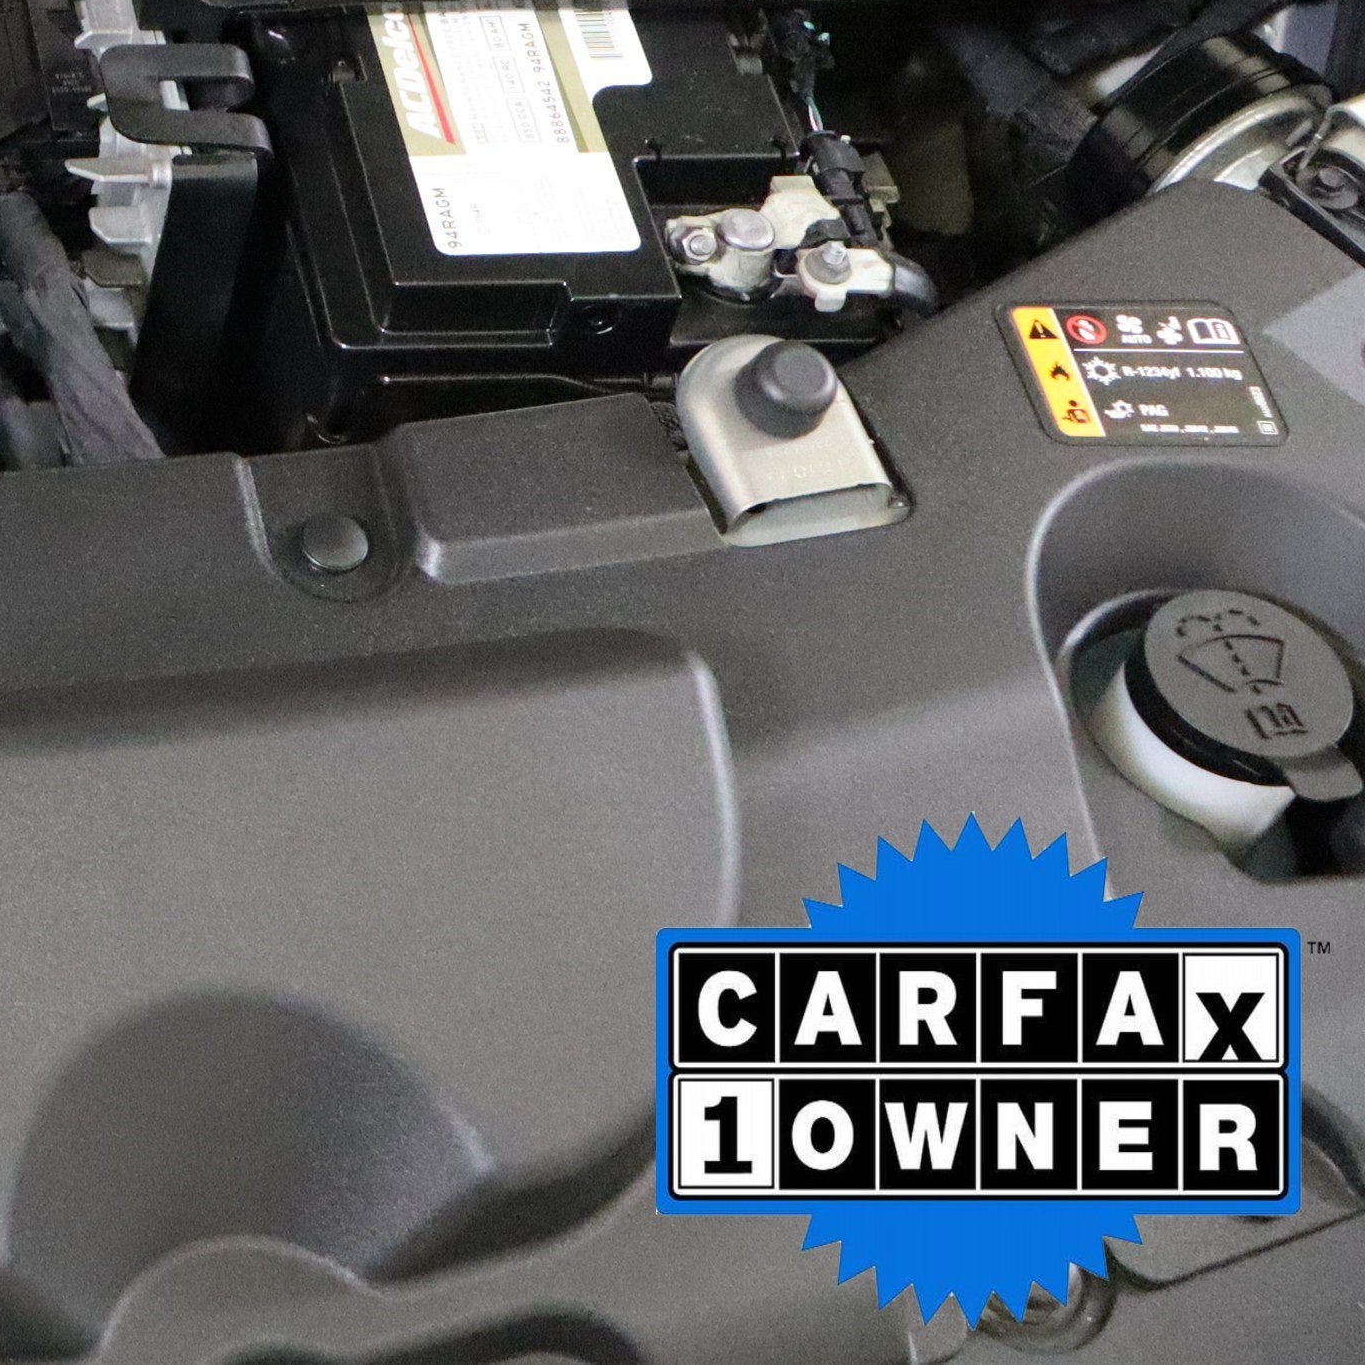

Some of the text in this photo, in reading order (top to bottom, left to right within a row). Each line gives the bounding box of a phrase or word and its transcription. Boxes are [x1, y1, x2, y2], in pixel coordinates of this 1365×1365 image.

[518, 23, 570, 143] 88864542 94RAGM
[432, 188, 463, 248] 94RAGM
[1121, 333, 1153, 345] AUTO
[1121, 365, 1243, 381] R-1234yf 1.100 kg
[1138, 403, 1170, 417] PAG
